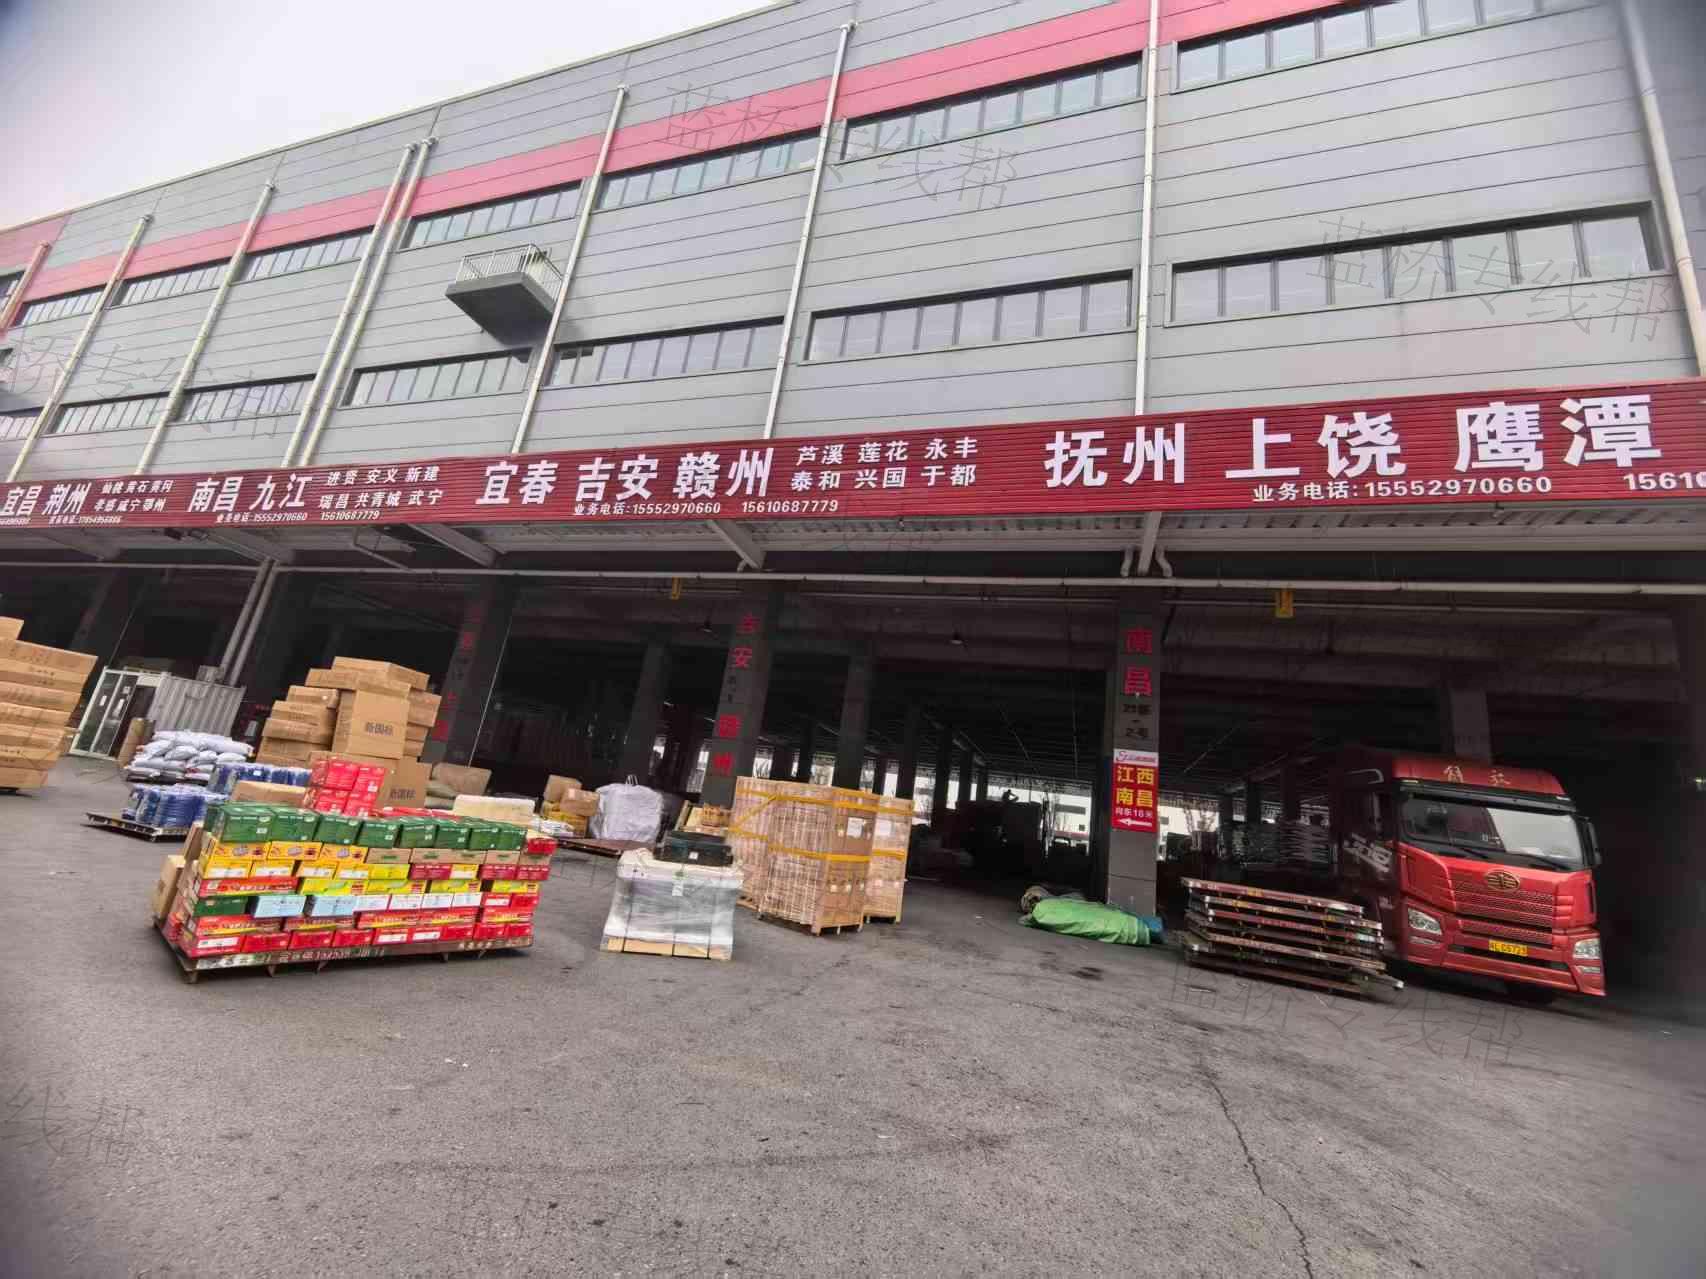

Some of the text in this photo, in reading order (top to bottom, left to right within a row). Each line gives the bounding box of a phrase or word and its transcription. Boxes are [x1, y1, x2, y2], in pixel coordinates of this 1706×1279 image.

[796, 437, 978, 466] 芦溪 莲花 永丰
[1044, 394, 1662, 487] 抚州 上饶 鹰潭
[327, 466, 440, 486] 进贤 安义 新建
[476, 448, 774, 505] 宜春 吉安 赣州
[791, 464, 977, 491] 泰和 兴国 于都
[0, 482, 91, 516] 宜昌 荆州
[188, 473, 312, 512] 南昌 九江
[317, 489, 444, 509] 瑞昌 共青城 武宁
[742, 499, 838, 513] 15610687779
[1125, 629, 1152, 694] 南昌
[1116, 765, 1155, 785] 江西
[1115, 787, 1153, 807] 南昌
